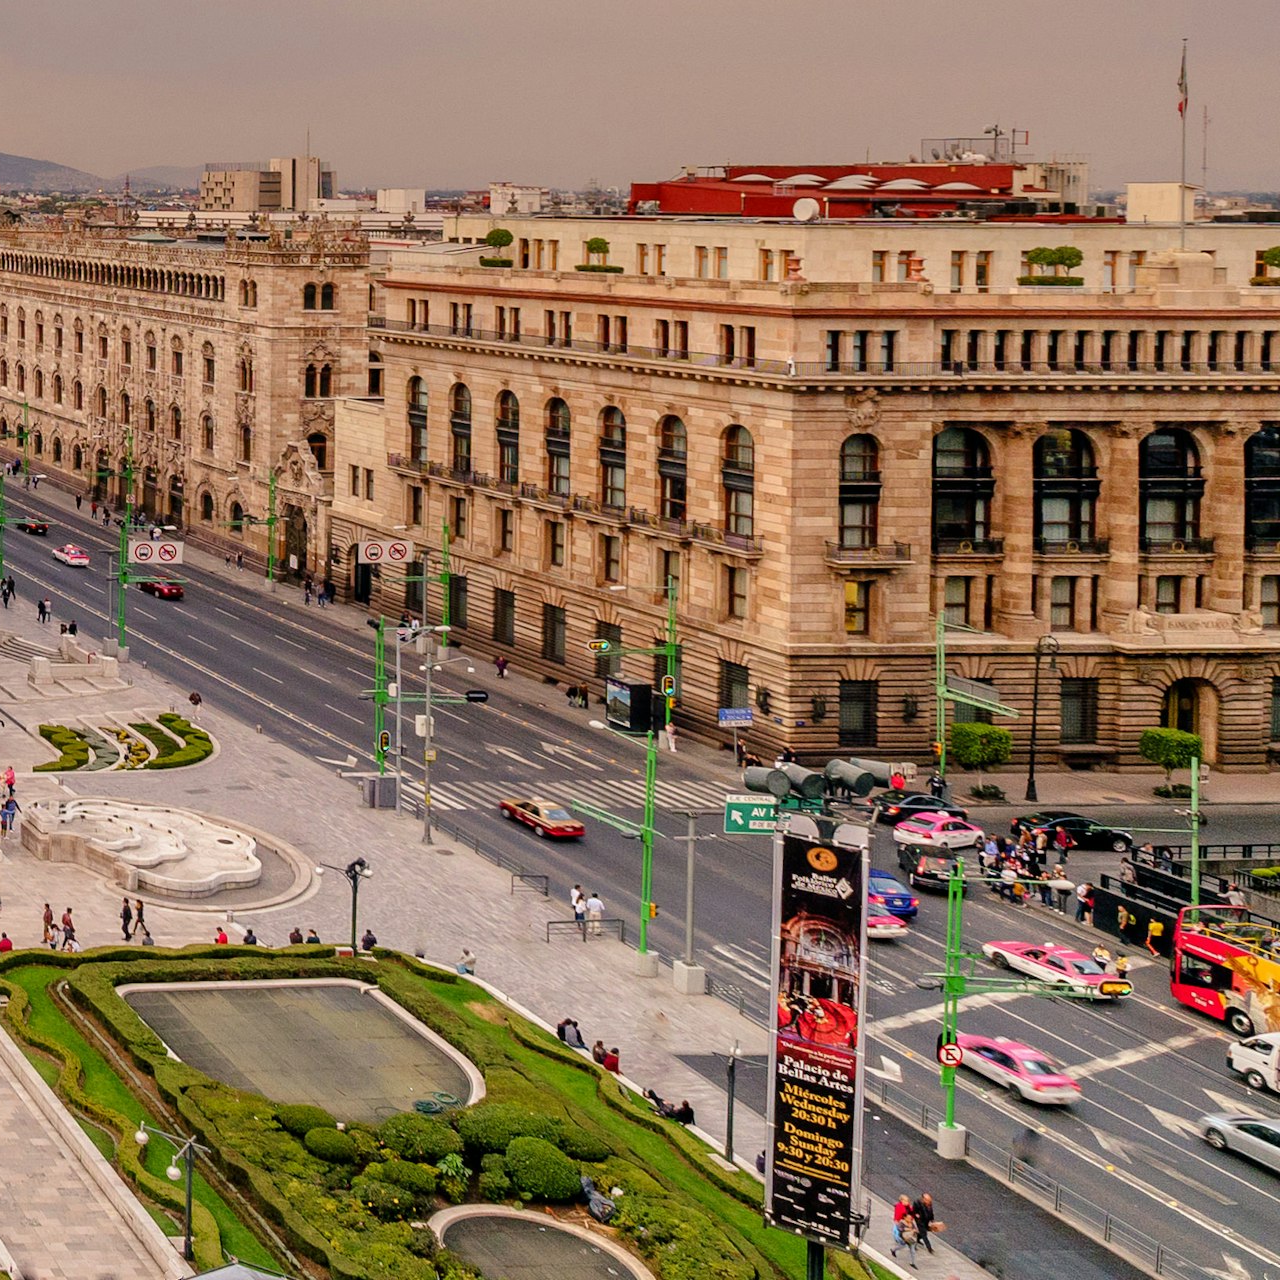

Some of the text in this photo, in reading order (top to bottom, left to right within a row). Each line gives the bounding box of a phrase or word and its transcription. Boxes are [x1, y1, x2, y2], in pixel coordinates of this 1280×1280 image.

[751, 807, 767, 817] AV
[811, 872, 837, 884] Ballet
[778, 1063, 854, 1093] Bellas Artes
[784, 1055, 831, 1077] Palacio
[832, 1069, 849, 1082] de
[779, 1091, 851, 1123] Wednesday
[784, 1082, 847, 1109] Miércoles
[791, 1107, 837, 1129] 20:30 h
[784, 1121, 844, 1149] Domingo
[790, 1135, 837, 1159] Sunday
[777, 1142, 804, 1159] 9:30
[804, 1153, 813, 1163] y
[814, 1154, 850, 1172] 20:30
